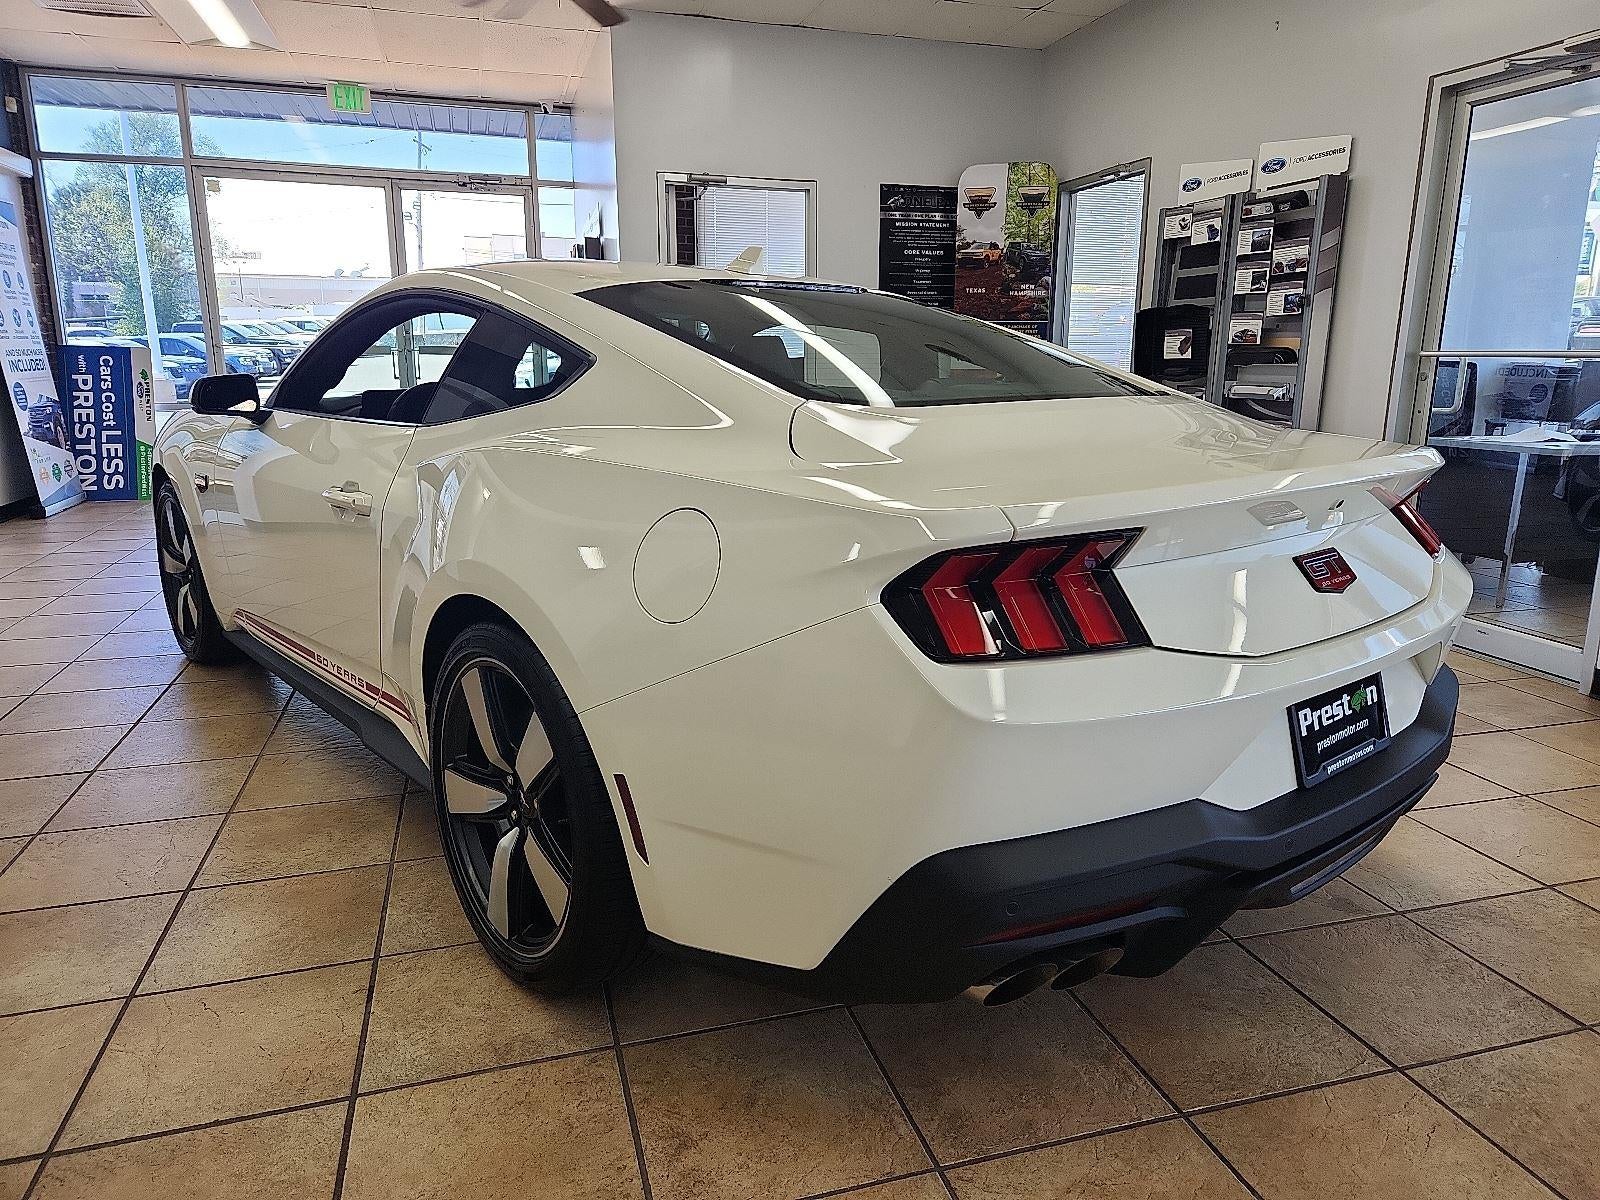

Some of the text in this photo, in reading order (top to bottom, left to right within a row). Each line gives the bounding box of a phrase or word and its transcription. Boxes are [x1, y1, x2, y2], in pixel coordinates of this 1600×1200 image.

[333, 84, 365, 111] EXIT
[1262, 159, 1286, 173] Ford
[1307, 147, 1347, 161] ACCESSORIES
[1183, 178, 1202, 191] Ford
[1219, 169, 1249, 181] ACCESSORIES
[8, 358, 47, 373] INCLUDED!
[144, 381, 153, 422] PRESTON
[72, 354, 98, 491] with PRESTON
[99, 355, 125, 491] Cars Cost LESS
[1302, 552, 1342, 580] GT
[316, 653, 366, 689] 60 YEARS
[1316, 718, 1369, 754] prestonmotor.com
[1326, 744, 1375, 775] prestonmotor.com
